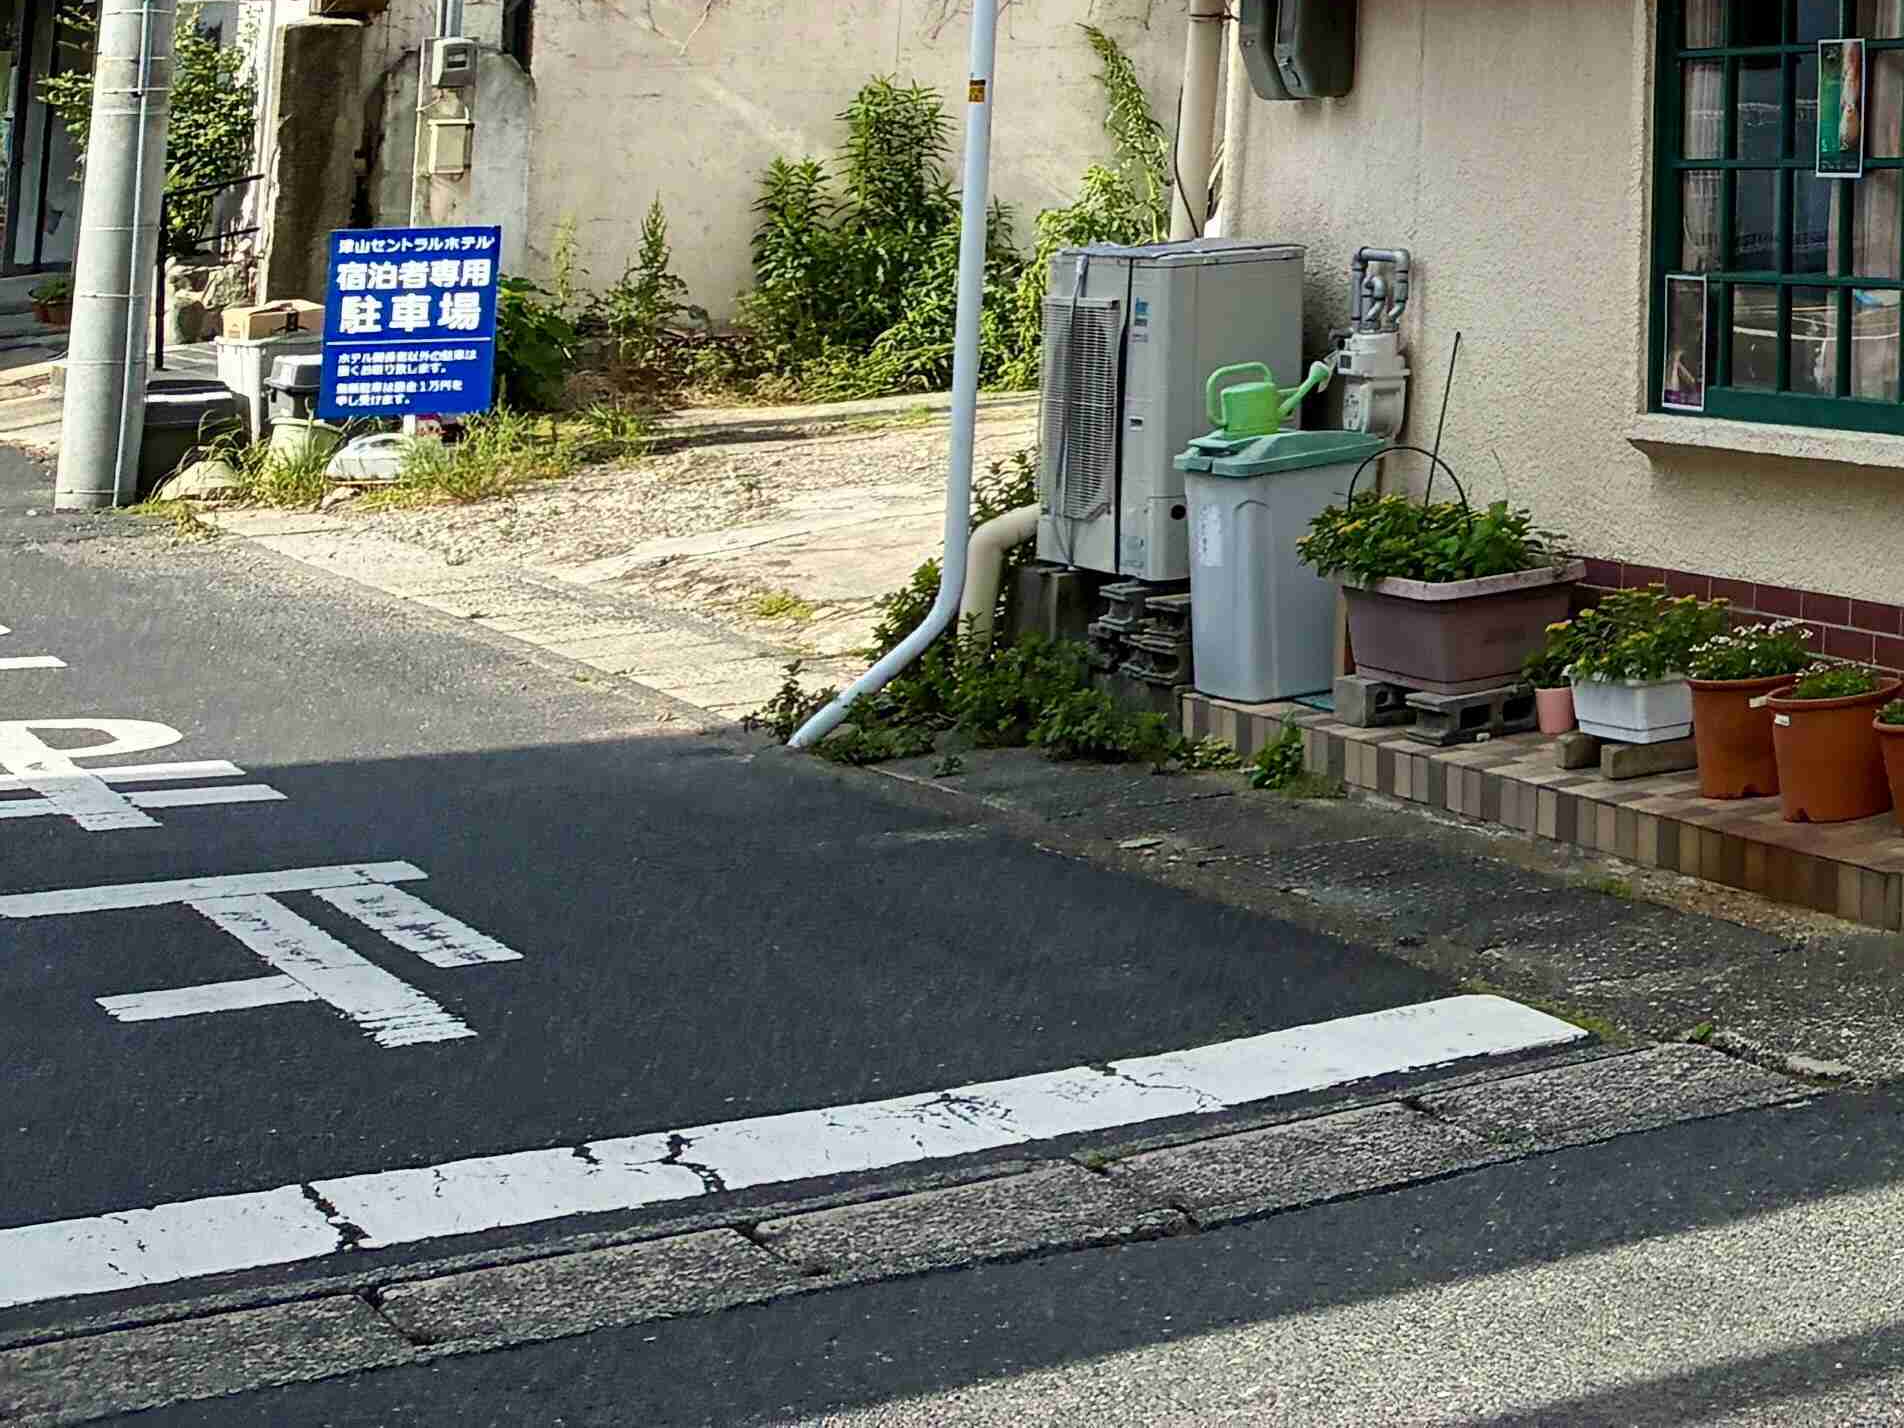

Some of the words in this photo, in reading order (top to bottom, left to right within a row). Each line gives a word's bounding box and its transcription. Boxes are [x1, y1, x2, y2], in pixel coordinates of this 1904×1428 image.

[336, 259, 491, 291] 宿泊者専用
[340, 292, 481, 333] 駐車場
